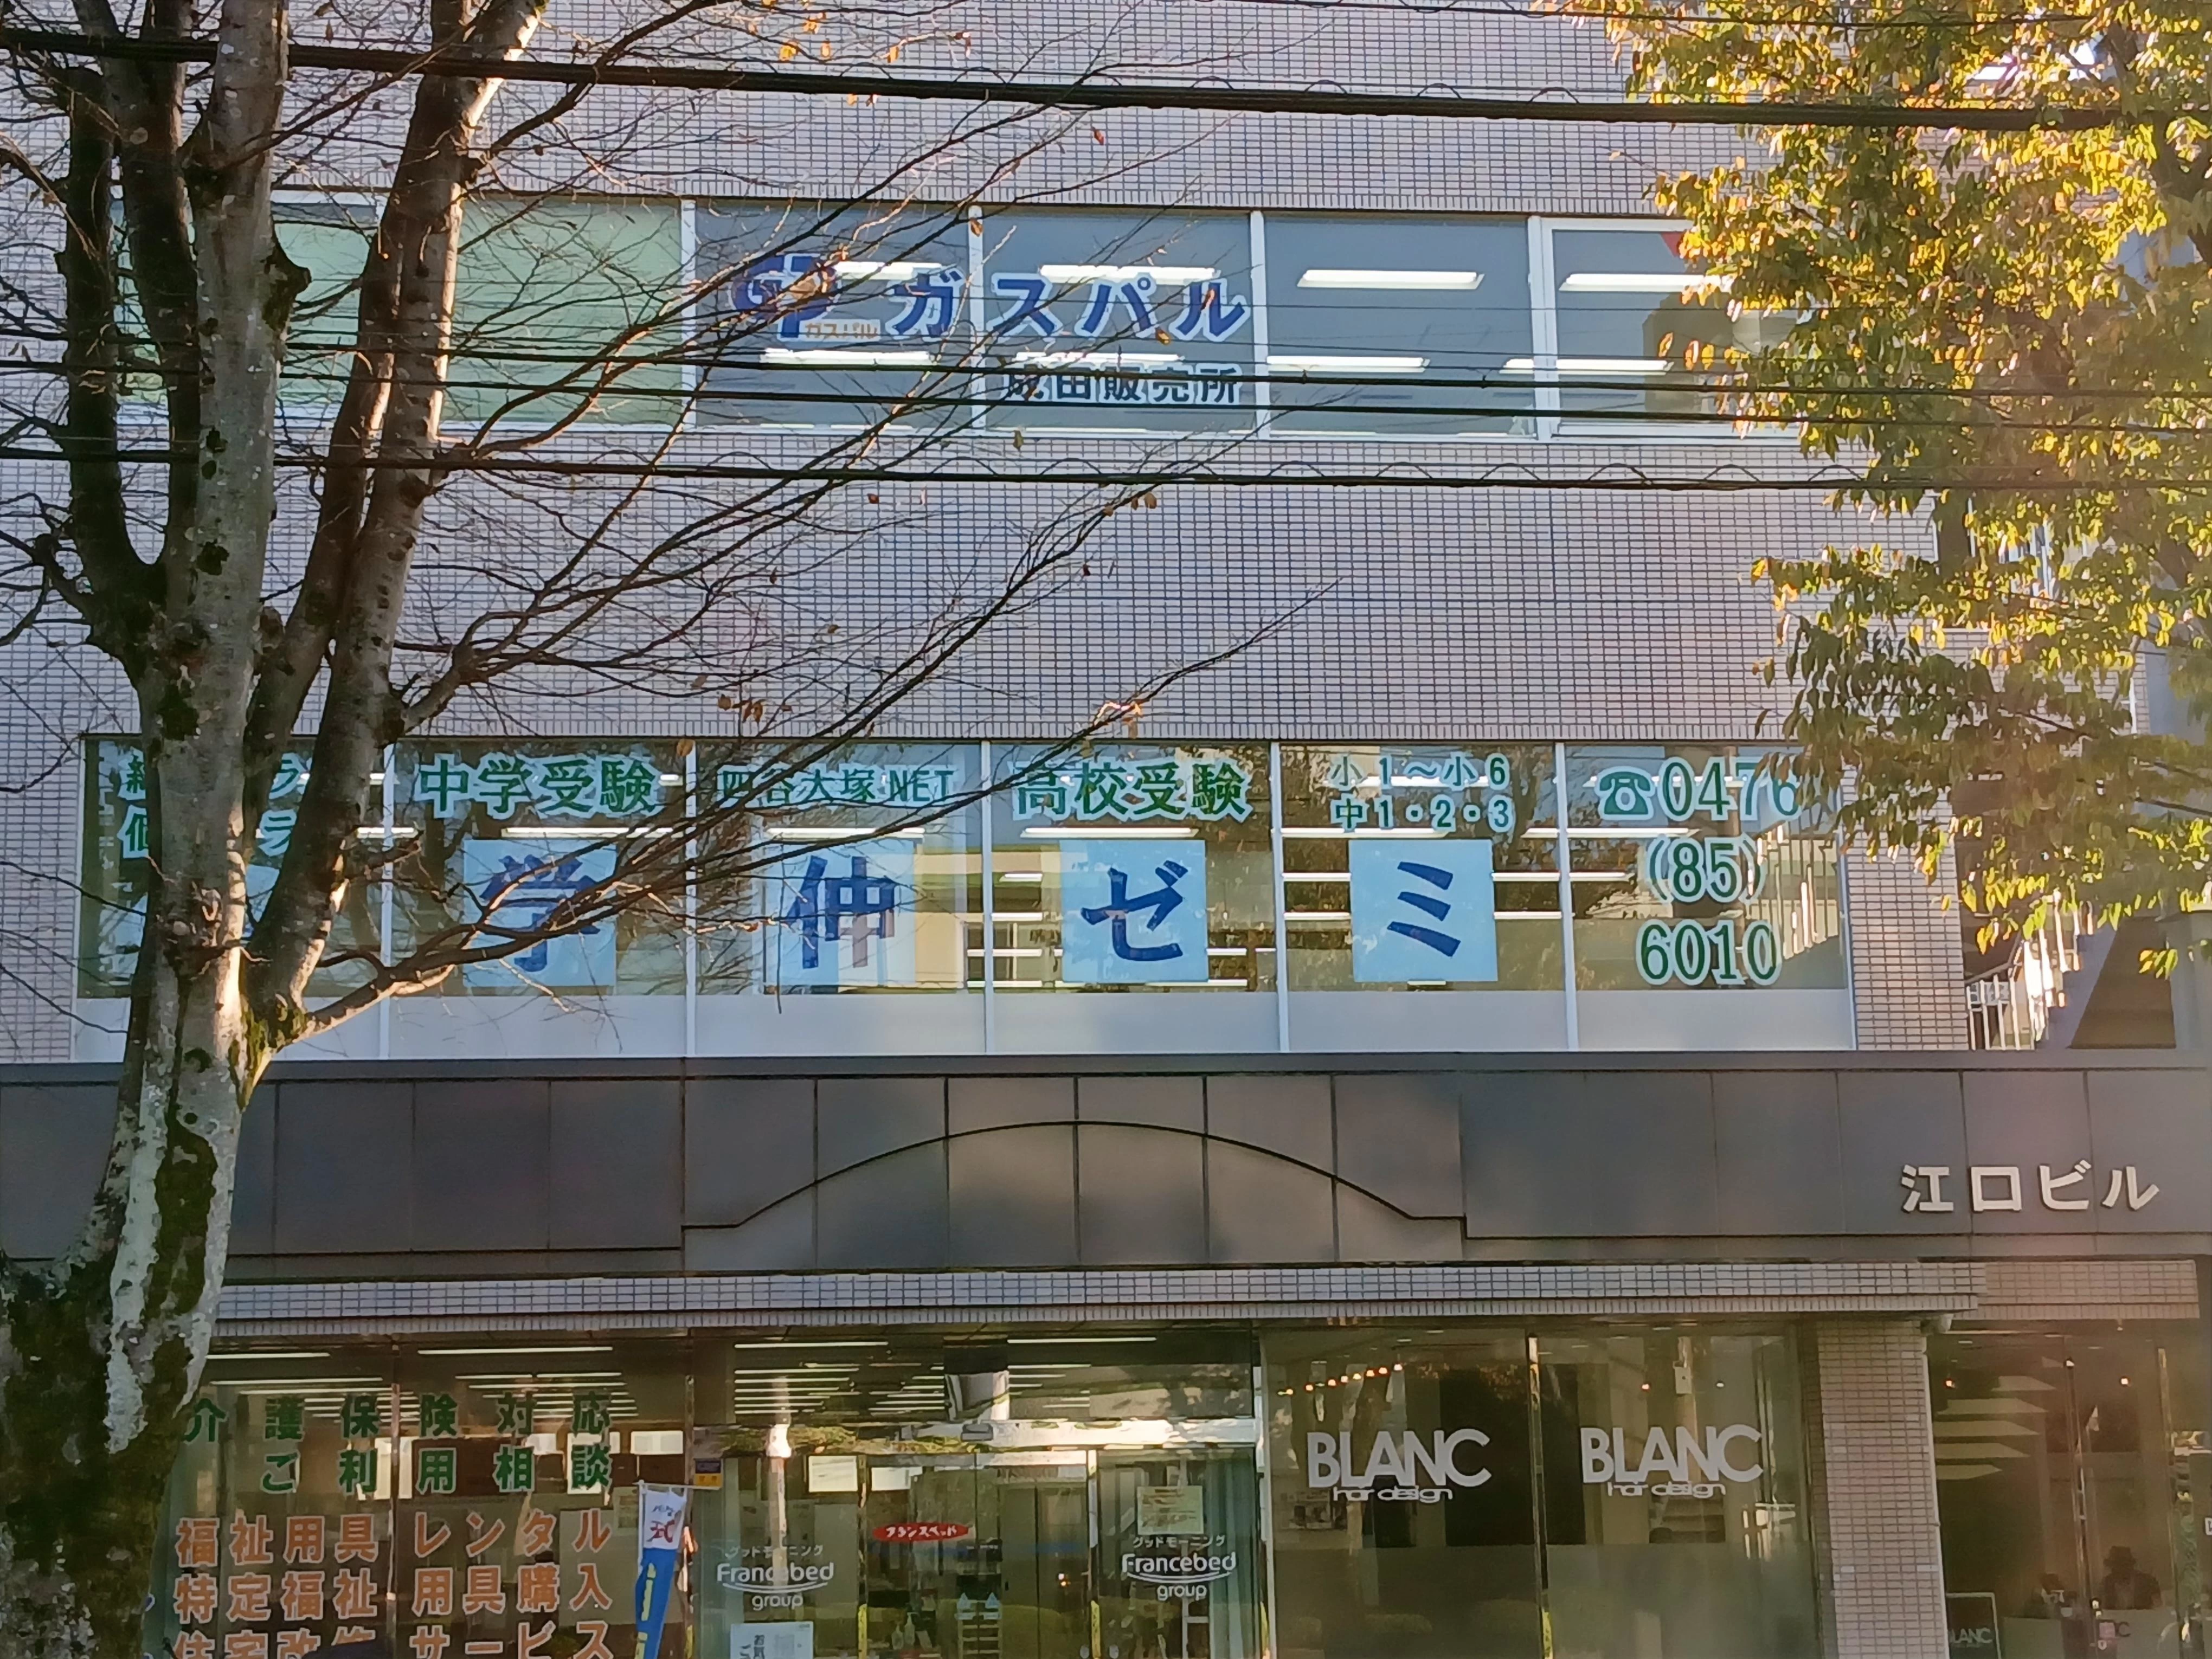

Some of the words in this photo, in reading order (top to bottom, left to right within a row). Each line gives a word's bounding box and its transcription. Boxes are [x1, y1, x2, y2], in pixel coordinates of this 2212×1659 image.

[889, 268, 1247, 340] ガスパル
[420, 757, 655, 813] 中学受験
[1013, 761, 1246, 815] 高校受験
[1649, 839, 1761, 901] (85)
[1641, 923, 1778, 980] 6010
[1901, 1159, 2160, 1212] 江口ビル
[1307, 1429, 1492, 1488] BLANC
[1580, 1424, 1763, 1483] BLANC
[724, 1545, 824, 1560] グッドモニング
[1122, 1551, 1237, 1573] Francebed
[751, 1592, 803, 1611] group
[1156, 1585, 1207, 1601] group
[1949, 1627, 1993, 1644] LANC
